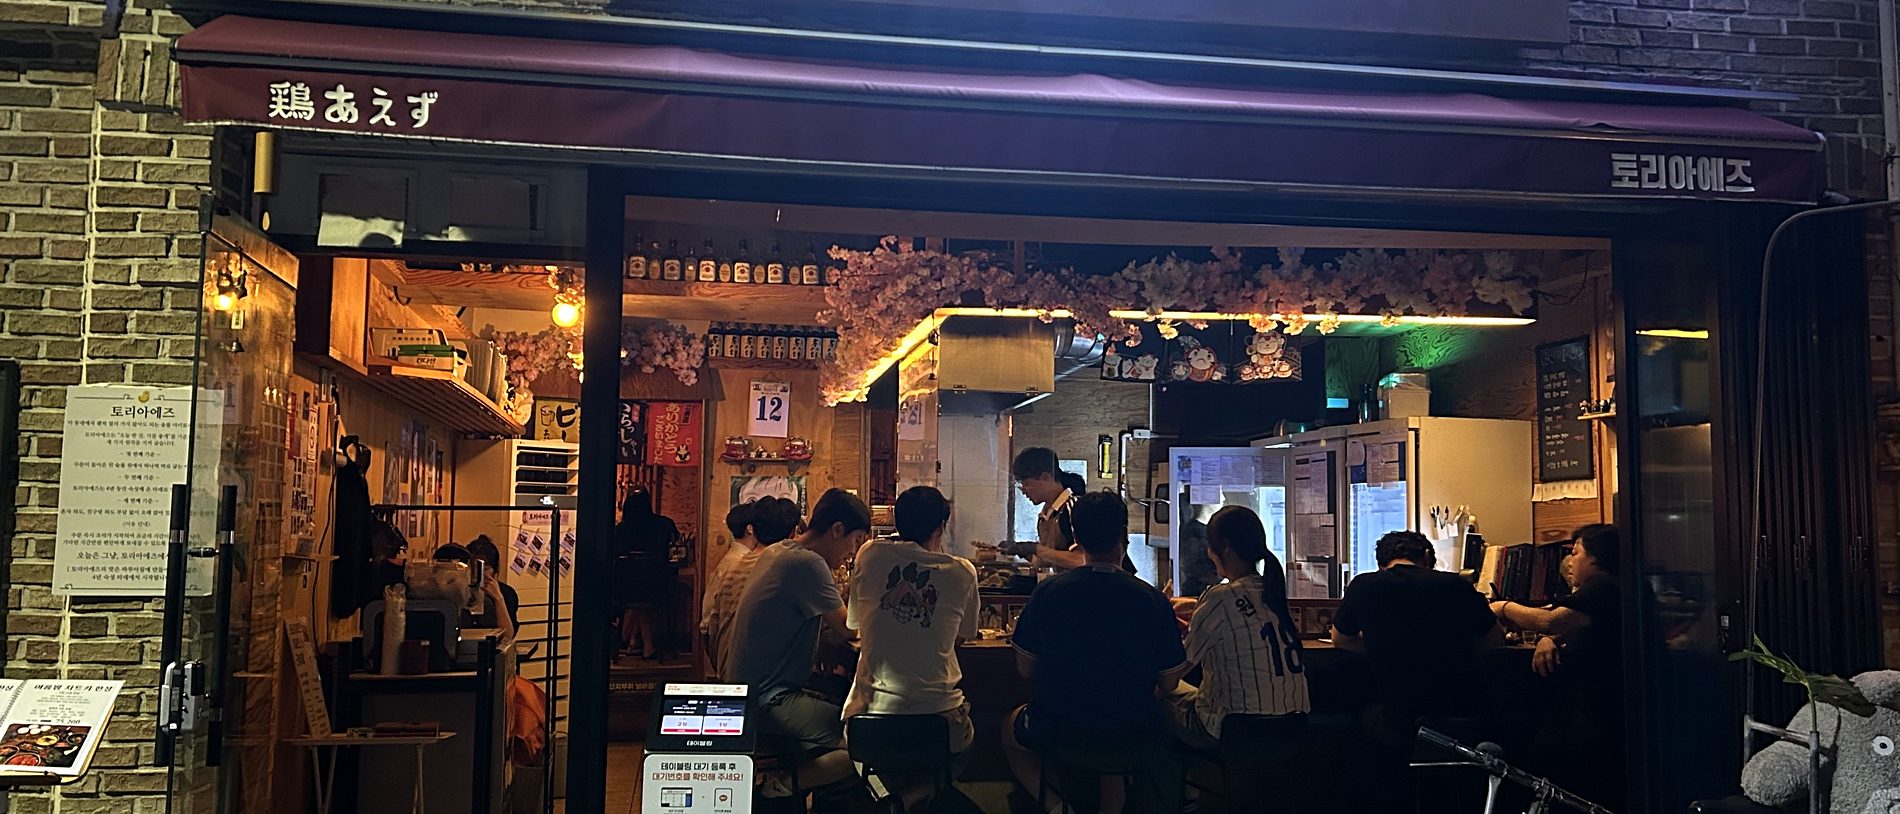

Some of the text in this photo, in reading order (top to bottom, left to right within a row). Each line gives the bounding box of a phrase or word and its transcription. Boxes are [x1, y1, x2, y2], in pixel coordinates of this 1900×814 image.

[268, 81, 439, 128] 鶏あえず
[1611, 153, 1755, 193] 토리아에즈
[110, 405, 175, 419] 토리아에즈
[755, 395, 782, 422] 12
[653, 414, 666, 464] ございました
[664, 402, 681, 454] ありがとう
[652, 773, 690, 781] 대기번호를
[692, 773, 716, 781] 확인해
[694, 763, 708, 771] 대기
[711, 763, 726, 771] 등록
[728, 763, 736, 771] 후
